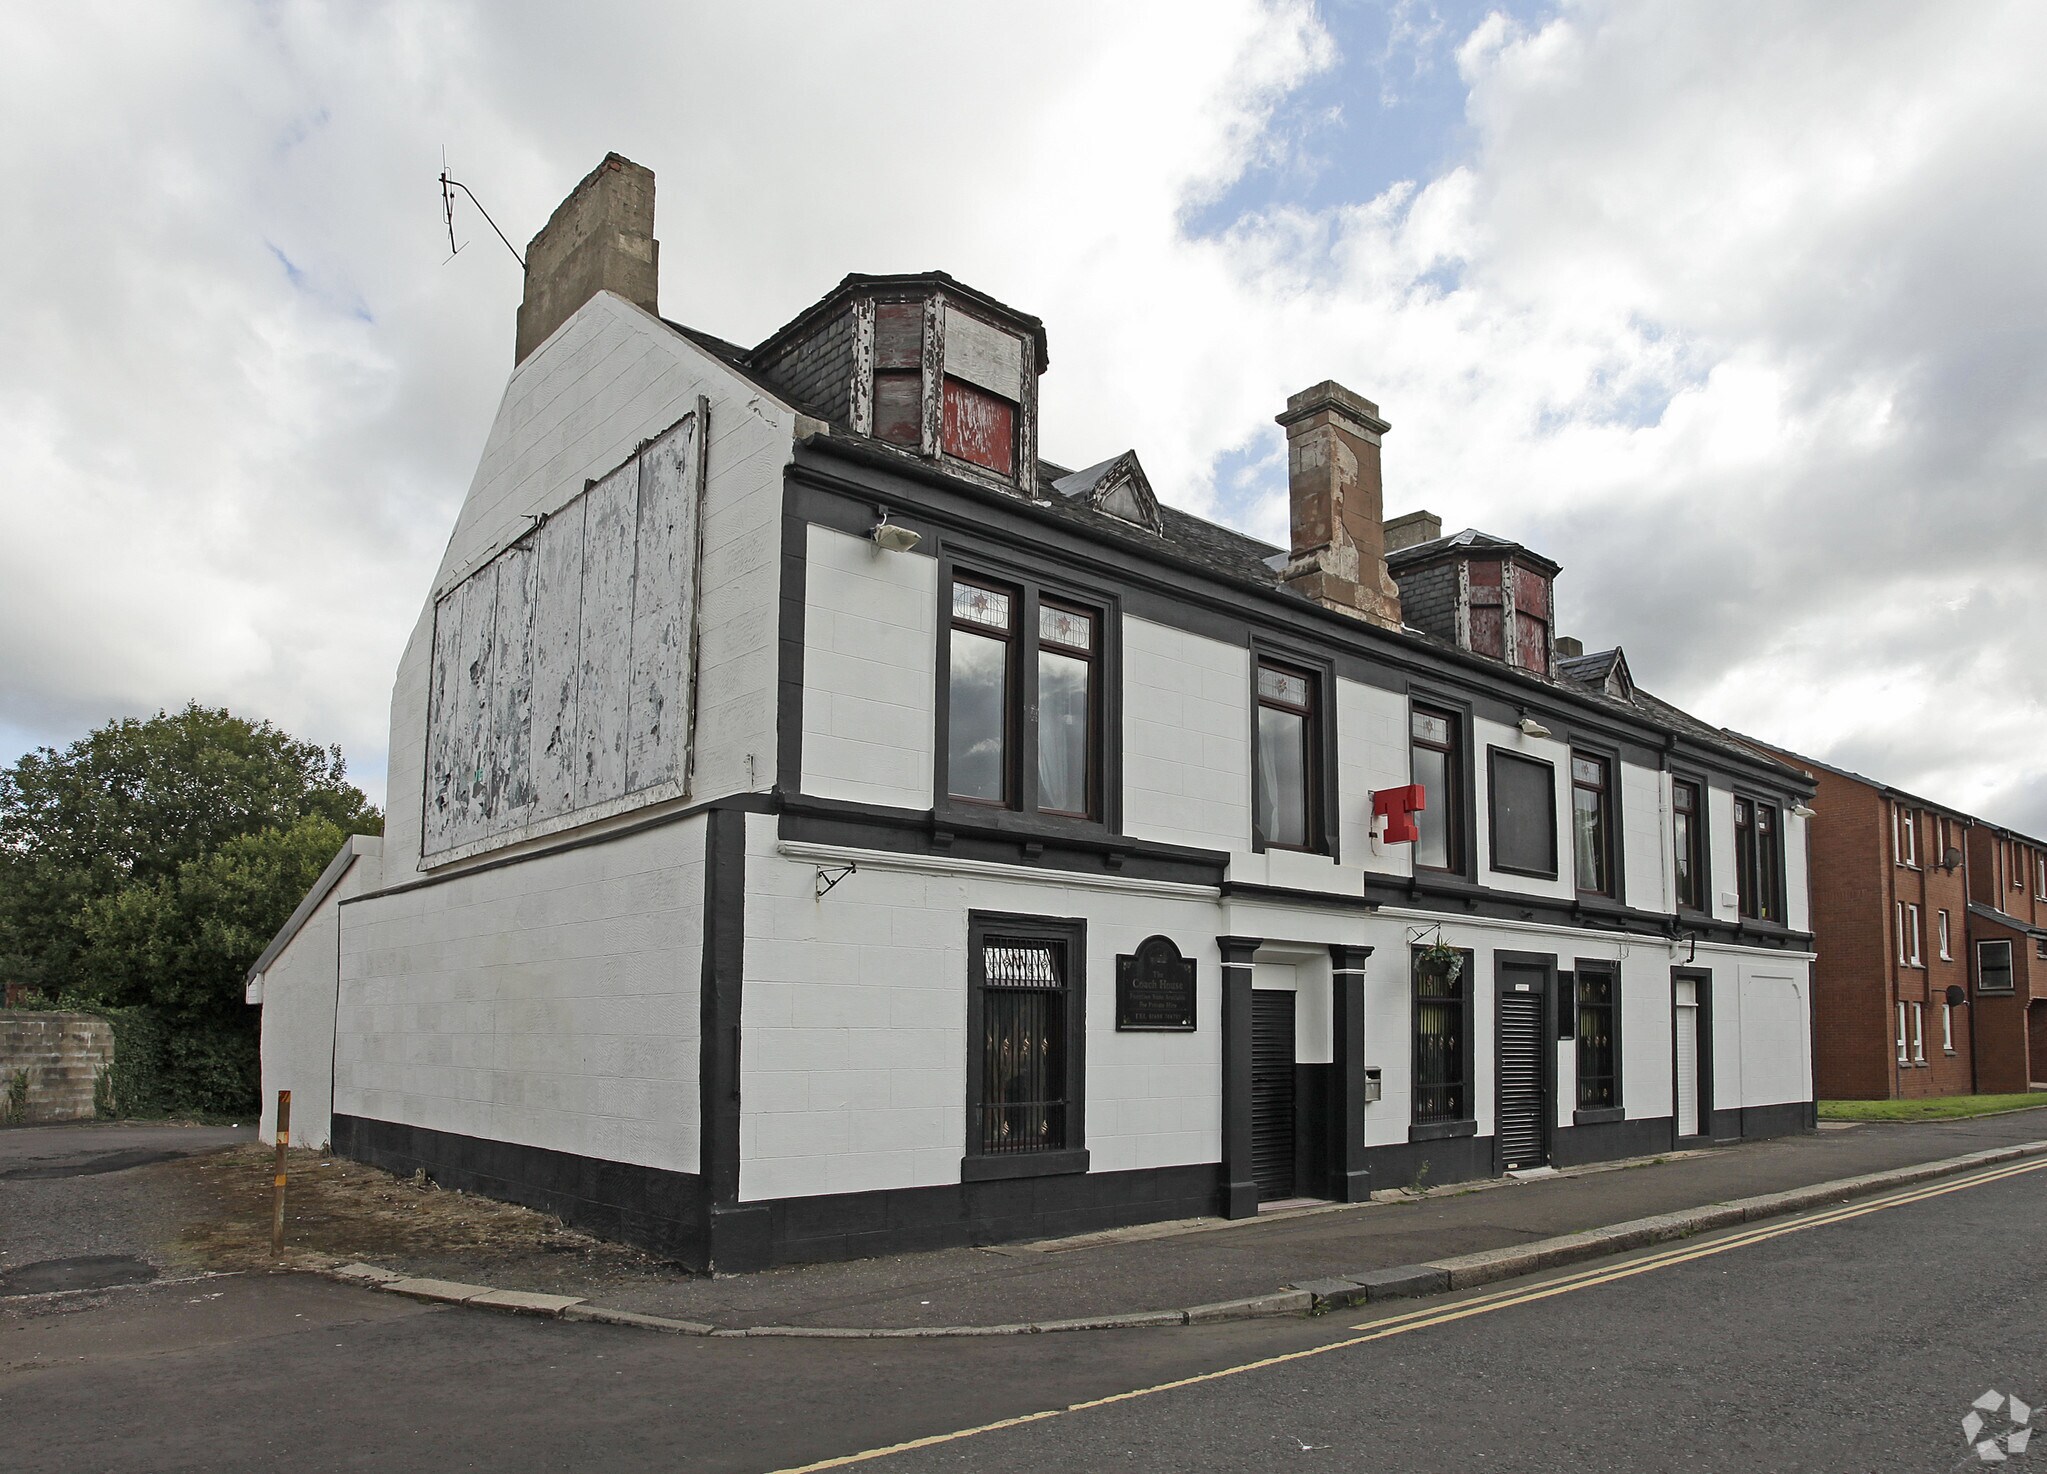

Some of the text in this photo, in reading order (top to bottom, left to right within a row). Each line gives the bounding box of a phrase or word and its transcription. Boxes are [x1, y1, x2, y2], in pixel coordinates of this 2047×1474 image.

[1374, 784, 1425, 844] T
[1132, 979, 1184, 990] Coach House
